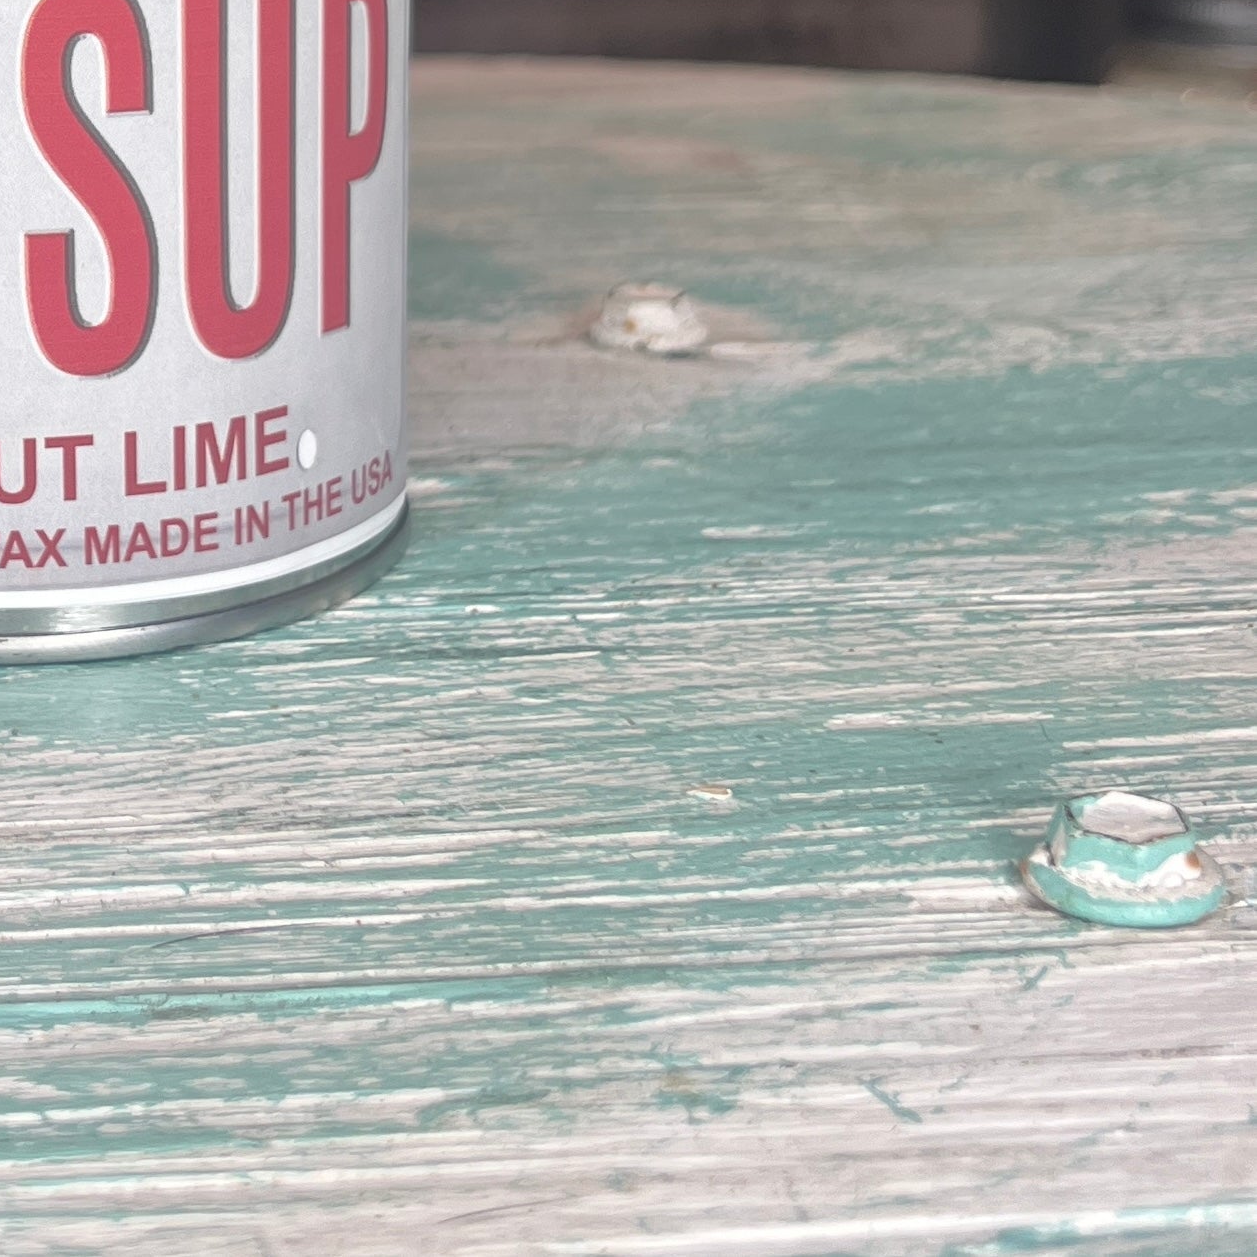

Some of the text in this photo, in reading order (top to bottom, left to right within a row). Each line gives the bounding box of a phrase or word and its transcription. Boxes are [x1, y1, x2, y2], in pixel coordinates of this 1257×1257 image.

[124, 405, 291, 496] LIME
[84, 511, 219, 565] MADE
[236, 500, 270, 545] IN
[282, 475, 343, 531] THE
[351, 449, 394, 505] USA
